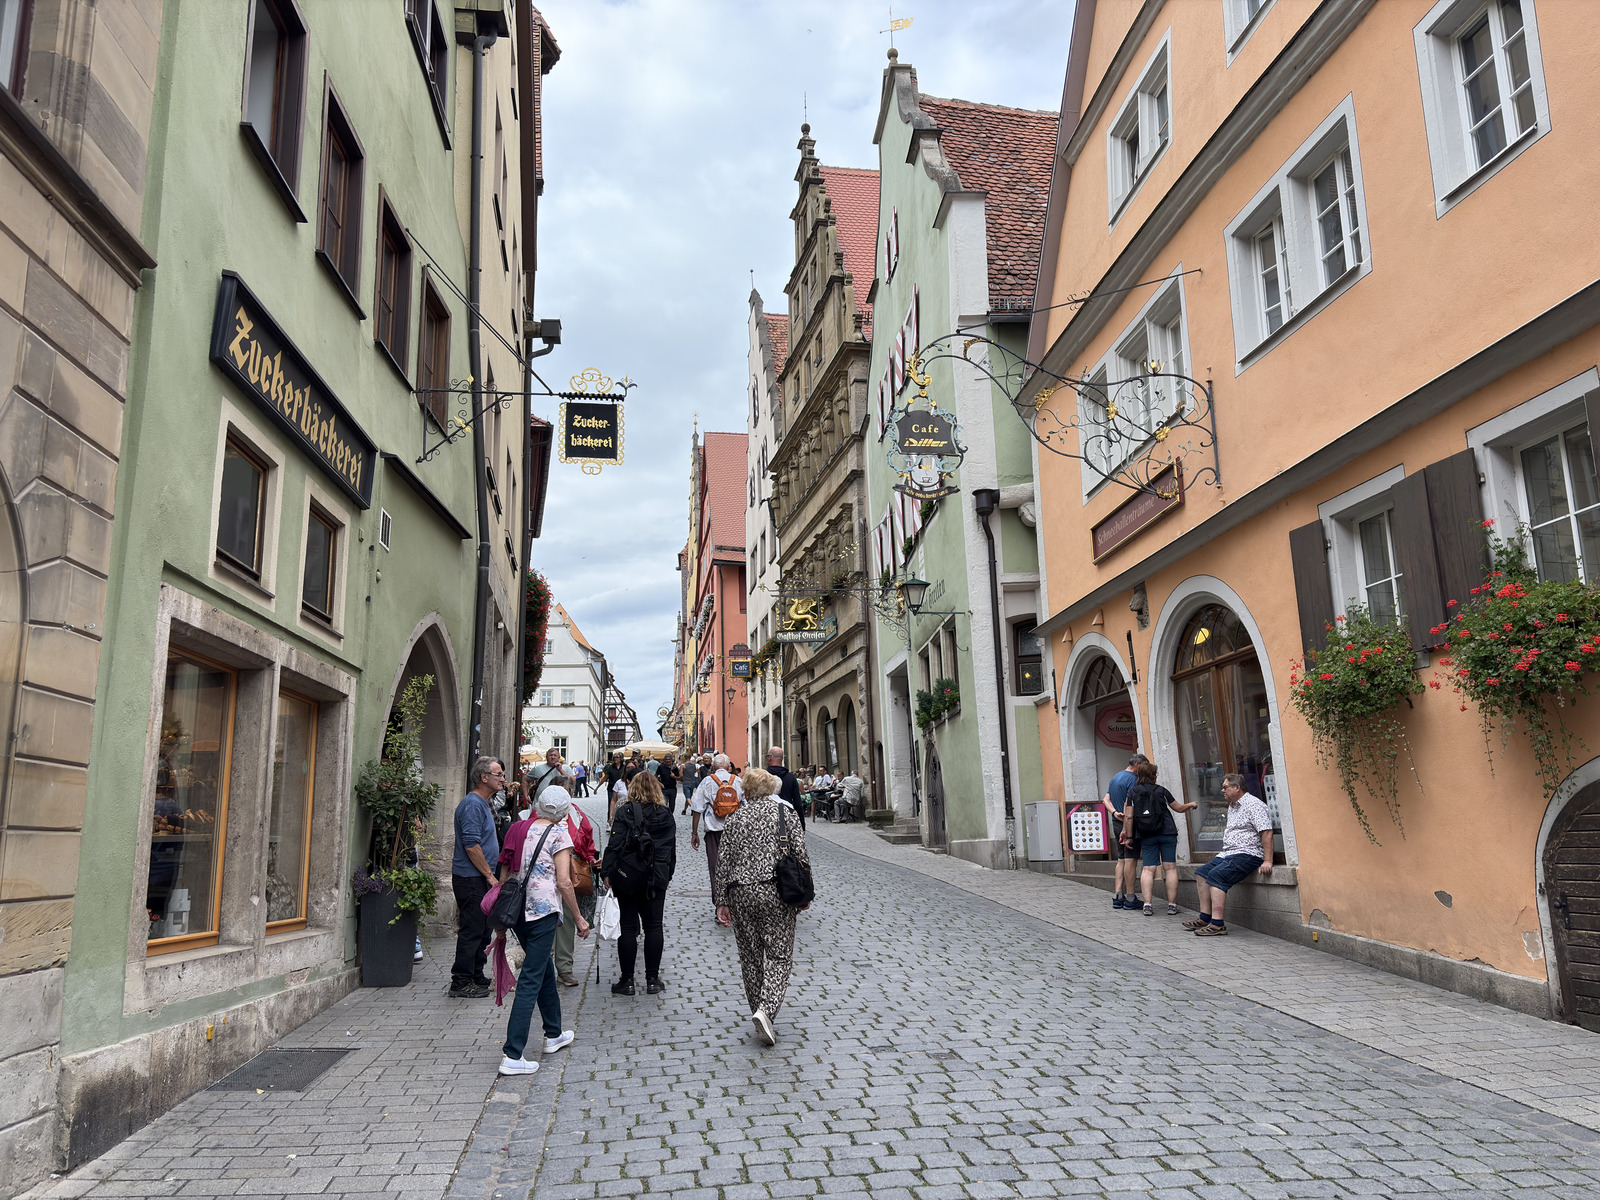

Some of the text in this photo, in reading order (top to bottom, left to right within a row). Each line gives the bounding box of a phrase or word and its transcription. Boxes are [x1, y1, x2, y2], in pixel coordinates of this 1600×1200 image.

[228, 305, 362, 491] Zuckerbäckerei
[572, 414, 611, 429] Zucker-
[911, 423, 939, 433] Cafe
[570, 433, 613, 450] bäckerei
[904, 437, 948, 447] Diller
[776, 631, 801, 641] Gasthof
